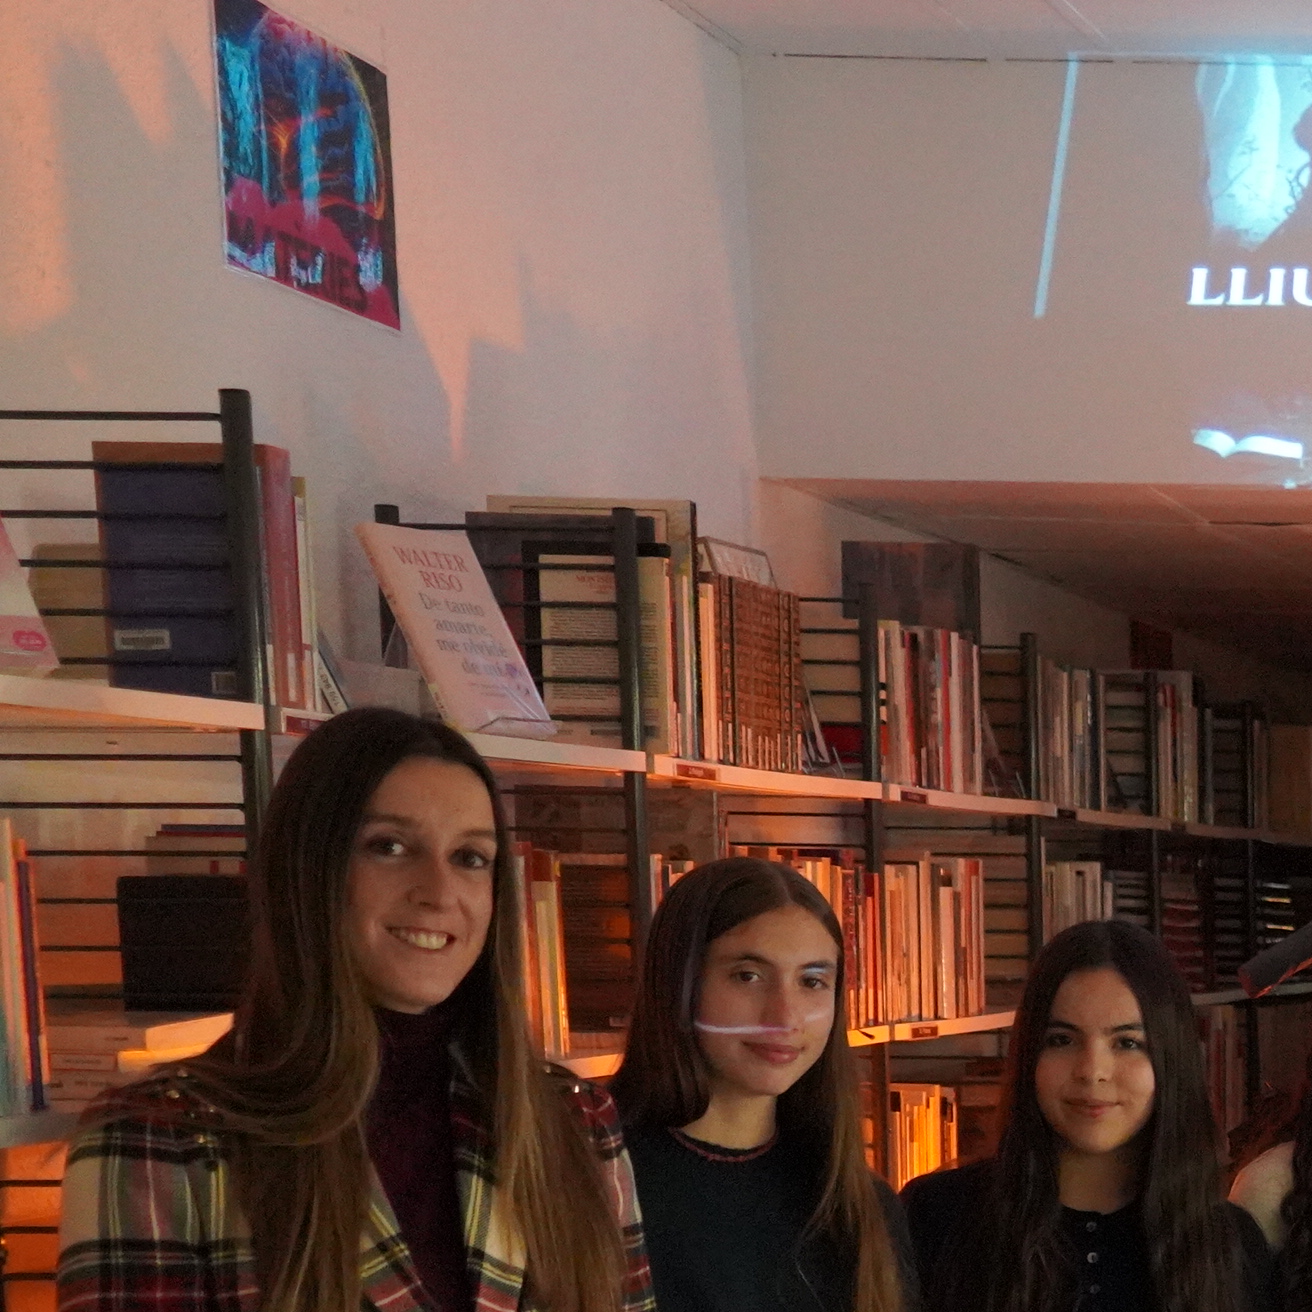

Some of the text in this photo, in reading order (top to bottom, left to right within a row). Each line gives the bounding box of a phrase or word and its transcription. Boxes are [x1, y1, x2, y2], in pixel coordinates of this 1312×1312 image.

[393, 546, 469, 572] WALTER
[420, 570, 463, 592] RISO
[444, 600, 485, 618] tanto
